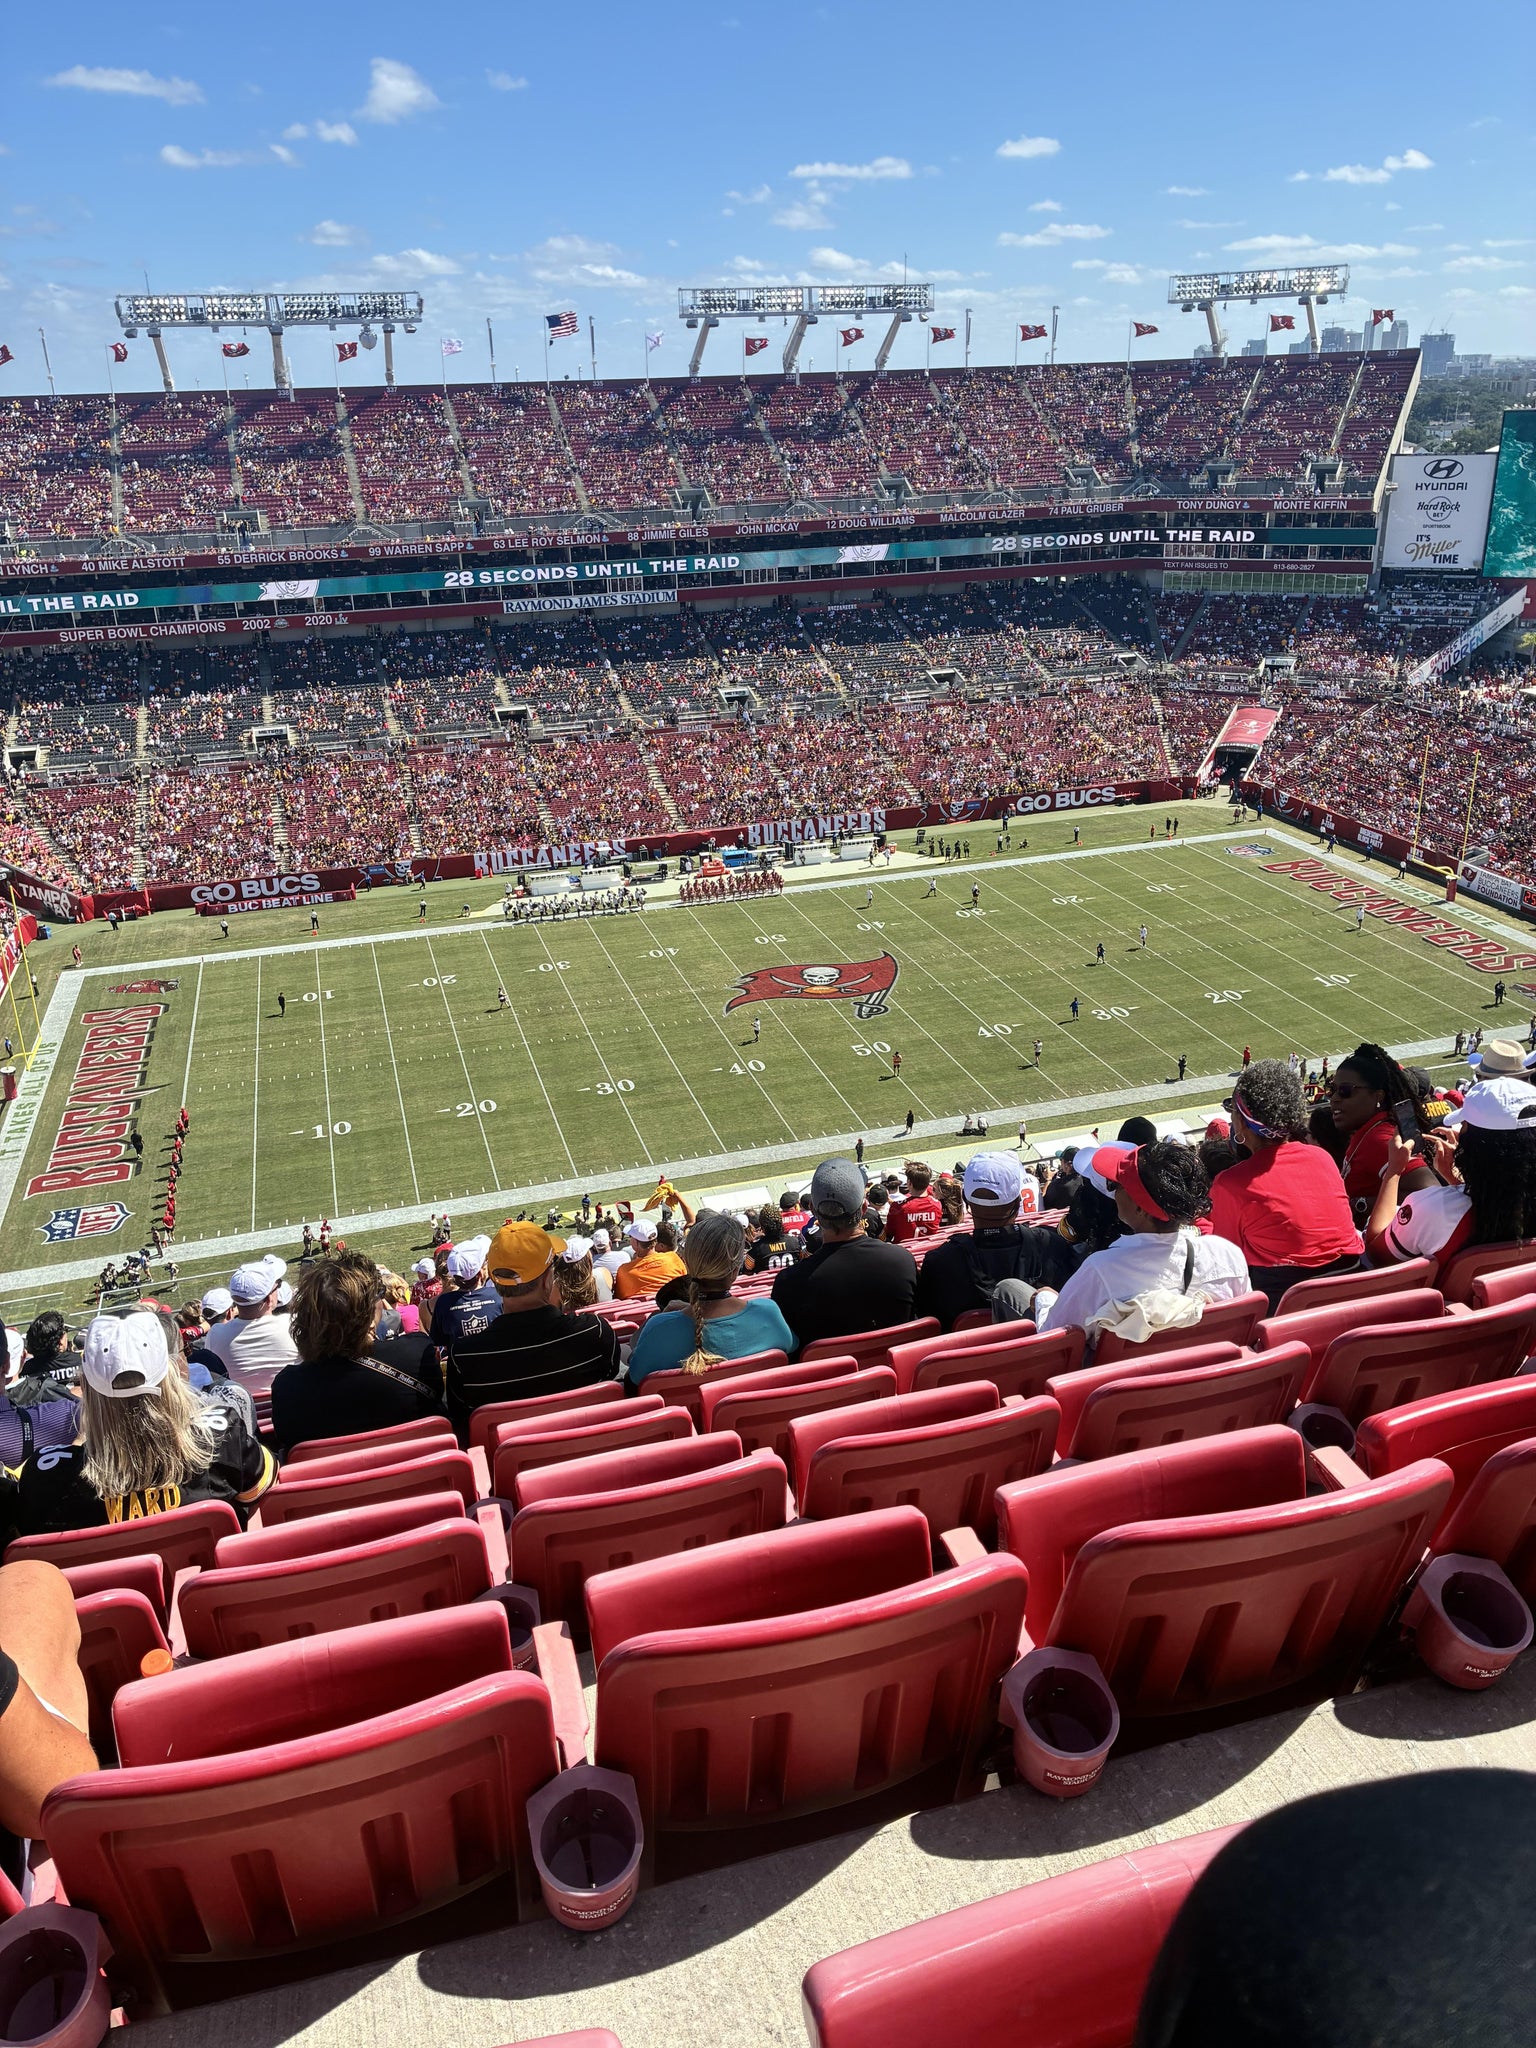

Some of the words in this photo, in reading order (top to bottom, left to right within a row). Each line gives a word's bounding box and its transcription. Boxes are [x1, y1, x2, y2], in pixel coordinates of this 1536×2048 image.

[1415, 482, 1468, 490] HYUNDAI
[1049, 507, 1058, 516] 74
[1061, 506, 1084, 516] PAUL
[1086, 503, 1124, 514] GRUBER
[1177, 501, 1203, 510] TONY
[1206, 501, 1241, 510] DUNGY
[1274, 501, 1312, 510] MONTE
[1314, 501, 1348, 510] KIFFIN
[1417, 502, 1440, 510] Hard
[1440, 502, 1460, 512] Rock
[826, 520, 836, 529] 12
[839, 518, 867, 528] DOUG
[869, 516, 916, 526] WILLIAMS
[940, 512, 986, 522] MALCOLM
[989, 510, 1024, 520] GLAZER
[628, 532, 639, 542] 88
[642, 530, 676, 541] JIMMIE
[679, 528, 709, 538] GILES
[736, 524, 764, 535] JOHN
[766, 522, 800, 534] MCKAY
[494, 540, 506, 549] 63
[508, 538, 528, 548] LEE
[532, 536, 553, 547] ROY
[556, 534, 600, 546] SELMON
[992, 537, 1016, 550] 28
[1021, 533, 1104, 548] SECONDS
[1110, 530, 1159, 542] UNTIL
[1166, 530, 1202, 542] THE
[1209, 530, 1255, 542] RAID
[1416, 534, 1430, 542] IT'S
[218, 554, 230, 564] 55
[235, 552, 286, 564] DERRICK
[290, 549, 338, 562] BROOKS
[368, 547, 382, 556] 99
[384, 544, 432, 556] WARREN
[436, 542, 464, 552] SAPP
[1404, 540, 1462, 562] Miller
[82, 562, 95, 572] 40
[98, 560, 128, 571] MIKE
[132, 557, 186, 569] ALSTOTT
[1432, 554, 1458, 564] TIME
[8, 564, 48, 576] LYNCH
[444, 571, 474, 587] 28
[479, 566, 578, 584] SECONDS
[584, 562, 643, 578] UNTIL
[650, 559, 688, 572] THE
[694, 556, 740, 570] RAID
[27, 596, 75, 612] THE
[82, 593, 139, 608] RAID
[505, 597, 573, 613] RAYMOND
[575, 595, 618, 608] JAMES
[621, 591, 676, 605] STADIUM
[242, 618, 271, 630] 2002
[304, 614, 332, 626] 2020
[60, 629, 104, 642] SUPER
[108, 627, 148, 640] BOWL
[150, 622, 227, 637] CHAMPIONS
[1016, 794, 1052, 812] GO
[1056, 786, 1116, 808] BUCS
[748, 810, 886, 846] BUCCANEERS
[190, 882, 236, 903] GO
[240, 874, 320, 899] BUCS
[1384, 880, 1440, 902] CHOOS
[1478, 880, 1520, 899] BUCCANEERS
[1500, 879, 1512, 888] BAY
[18, 883, 72, 908] TAMPA
[1476, 886, 1518, 907] FOUNDATION
[228, 902, 258, 914] BUC
[262, 897, 300, 910] BEAT
[302, 893, 334, 905] LINE
[1258, 858, 1536, 974] BUCCANEERS
[856, 920, 886, 932] 40
[754, 934, 788, 945] 50
[648, 947, 680, 958] 40
[538, 960, 571, 972] 30
[422, 974, 458, 987] 20
[1314, 974, 1350, 988] 10
[302, 990, 335, 1001] 10
[1204, 989, 1243, 1004] 20
[1092, 1006, 1130, 1020] 30
[977, 1023, 1012, 1038] 40
[851, 1041, 891, 1056] 50
[729, 1059, 766, 1076] 40
[596, 1079, 636, 1095] 30
[23, 1003, 168, 1201] BUCCANEERS
[456, 1099, 497, 1118] 20
[5, 1101, 37, 1145] TAKES
[311, 1121, 352, 1140] 10
[78, 1204, 120, 1236] NFL
[908, 1212, 936, 1223] MAYFIELD
[769, 1242, 786, 1252] WATT
[104, 1482, 182, 1525] WARD
[562, 1906, 606, 1916] RAYMOND
